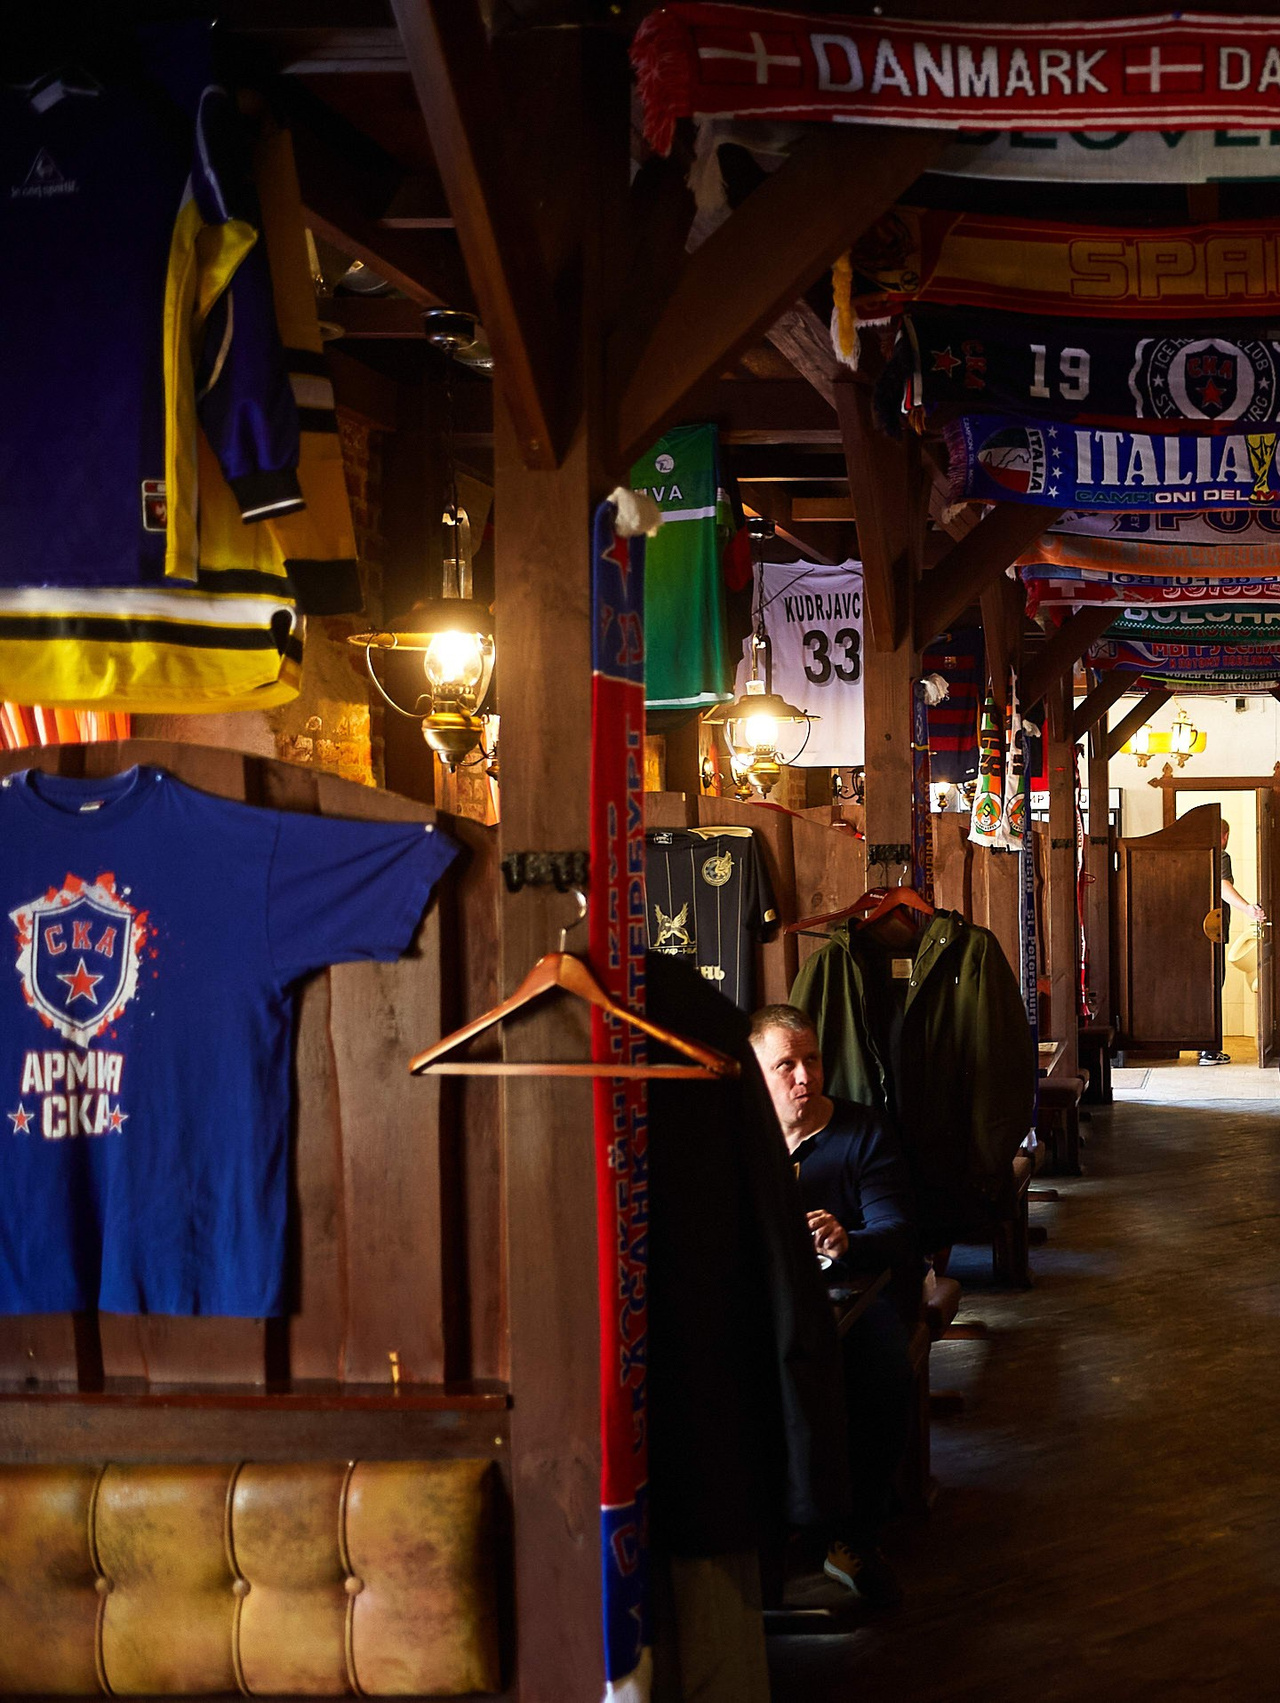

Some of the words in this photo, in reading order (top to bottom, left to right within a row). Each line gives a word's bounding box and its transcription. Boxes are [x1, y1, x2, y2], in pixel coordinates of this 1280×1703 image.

[810, 32, 1109, 98] DANMARK
[1029, 343, 1092, 401] 19
[1028, 430, 1044, 492] ITALIA
[1074, 430, 1254, 486] ITALIA
[1075, 490, 1197, 503] CAMPIONI
[1203, 489, 1250, 501] DEL
[784, 592, 861, 622] KUDRJAVC
[803, 627, 861, 684] 33
[44, 920, 118, 958] СКА
[20, 1050, 125, 1096] АРМИЯ
[41, 1093, 113, 1140] СКА
